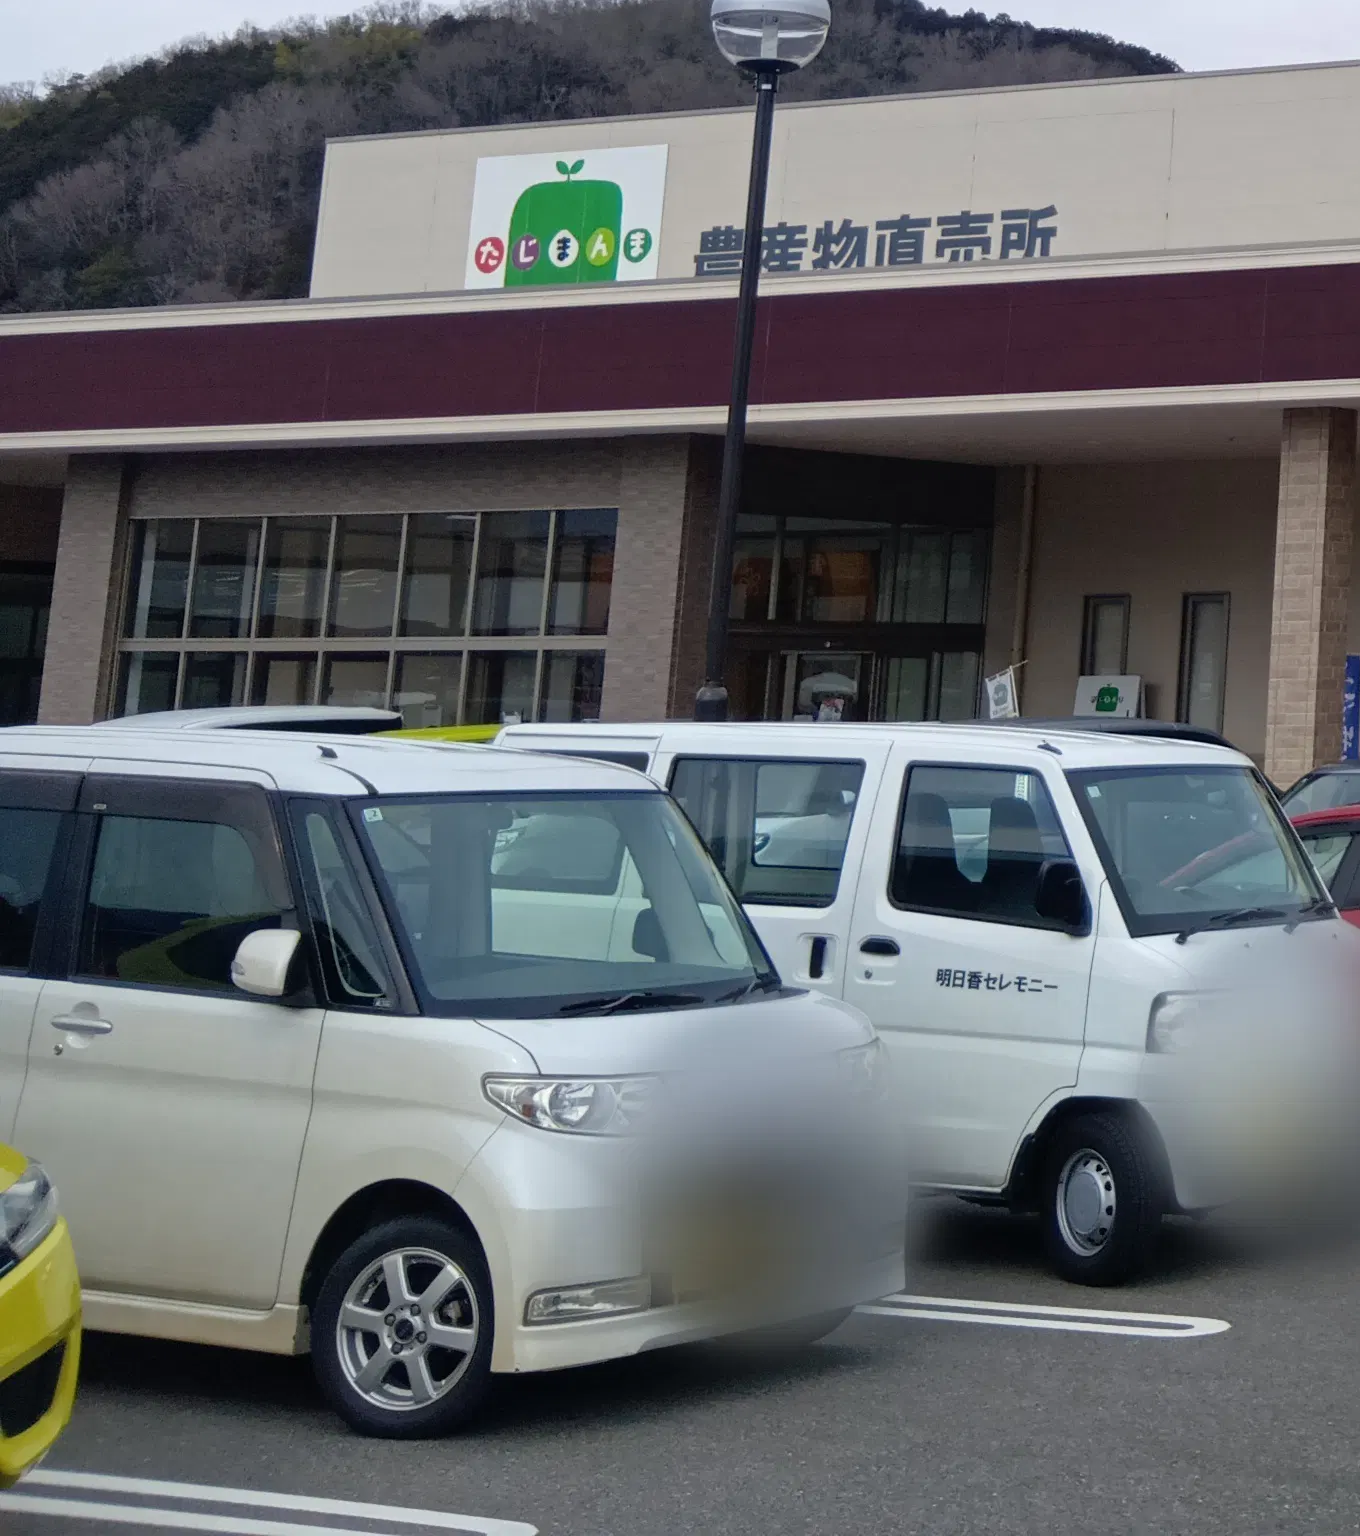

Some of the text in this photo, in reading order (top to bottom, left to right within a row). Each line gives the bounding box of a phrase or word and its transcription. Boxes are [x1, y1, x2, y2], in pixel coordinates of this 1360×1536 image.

[475, 227, 652, 273] たじまんま
[694, 204, 1058, 276] 農産物直売所
[935, 967, 1058, 993] 明日香セレモニー
